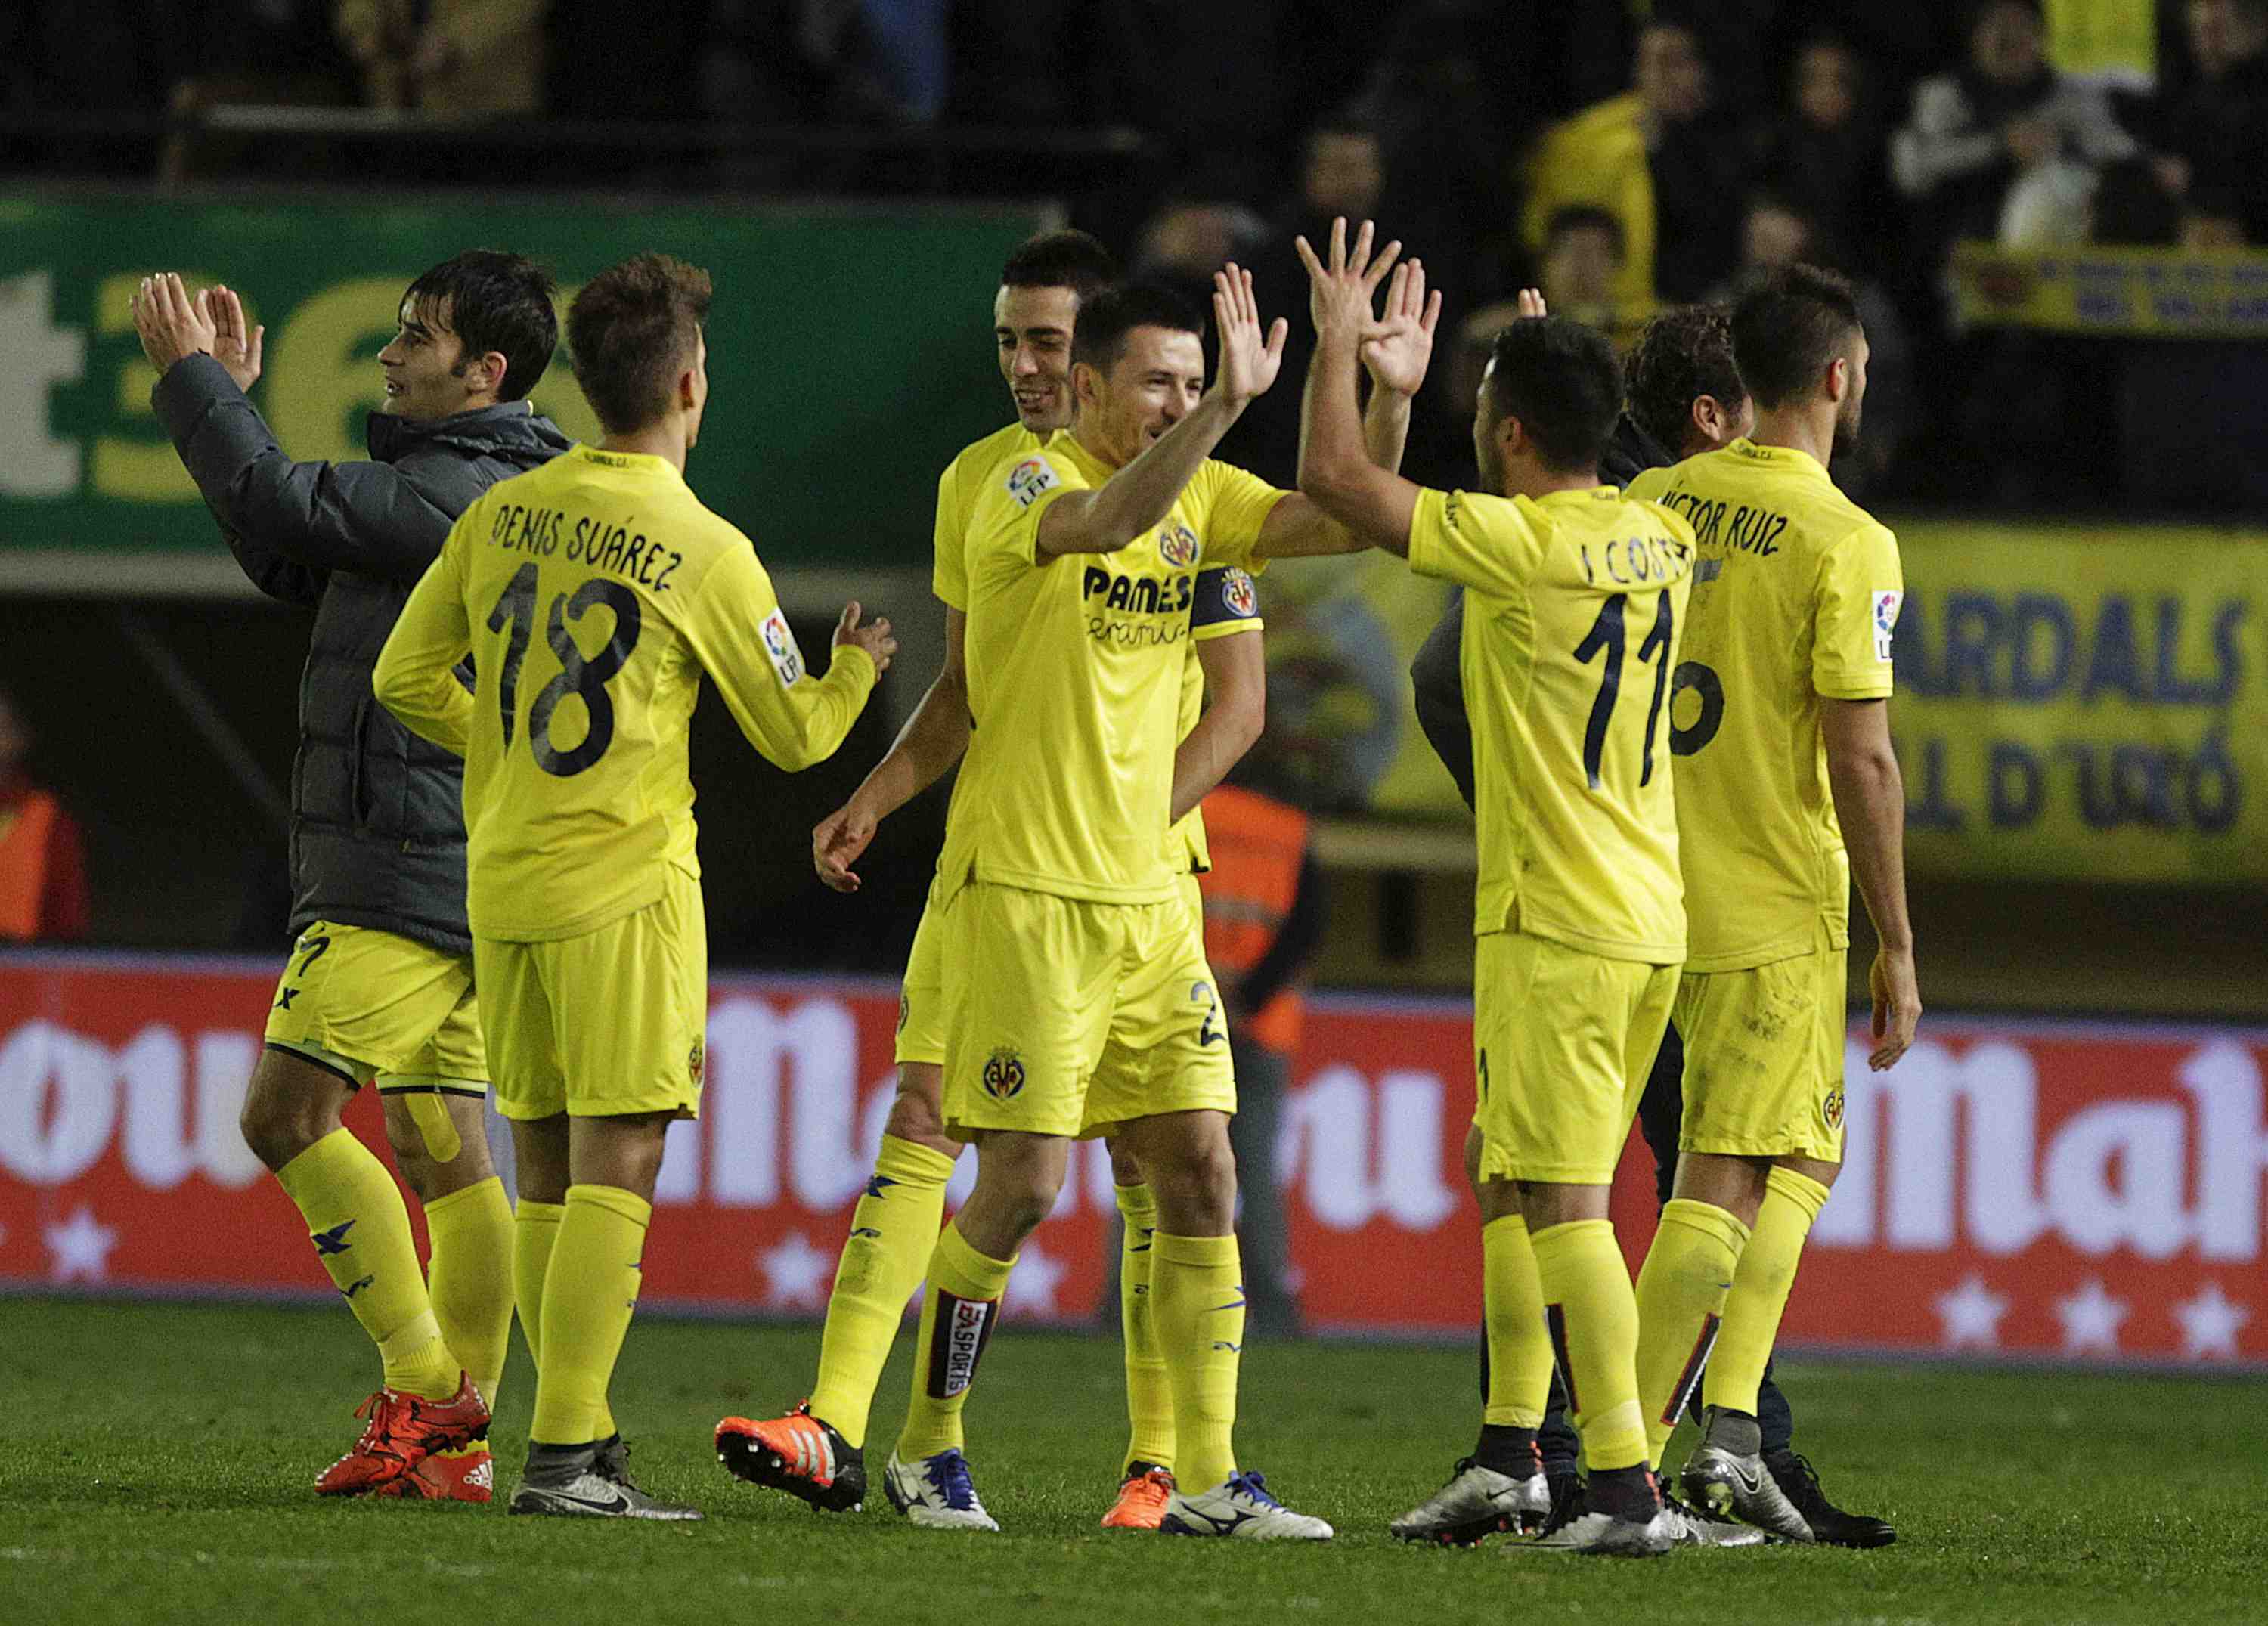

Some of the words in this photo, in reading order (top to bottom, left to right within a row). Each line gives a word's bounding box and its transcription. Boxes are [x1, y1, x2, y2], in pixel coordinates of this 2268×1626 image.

[488, 504, 565, 557] DENIS
[567, 515, 683, 592] SUÁREZ
[1724, 506, 1789, 557] RUIZ
[1084, 565, 1191, 614] PAMES
[486, 561, 642, 779] 18
[1573, 589, 1673, 789] 11
[1191, 980, 1228, 1047] 2
